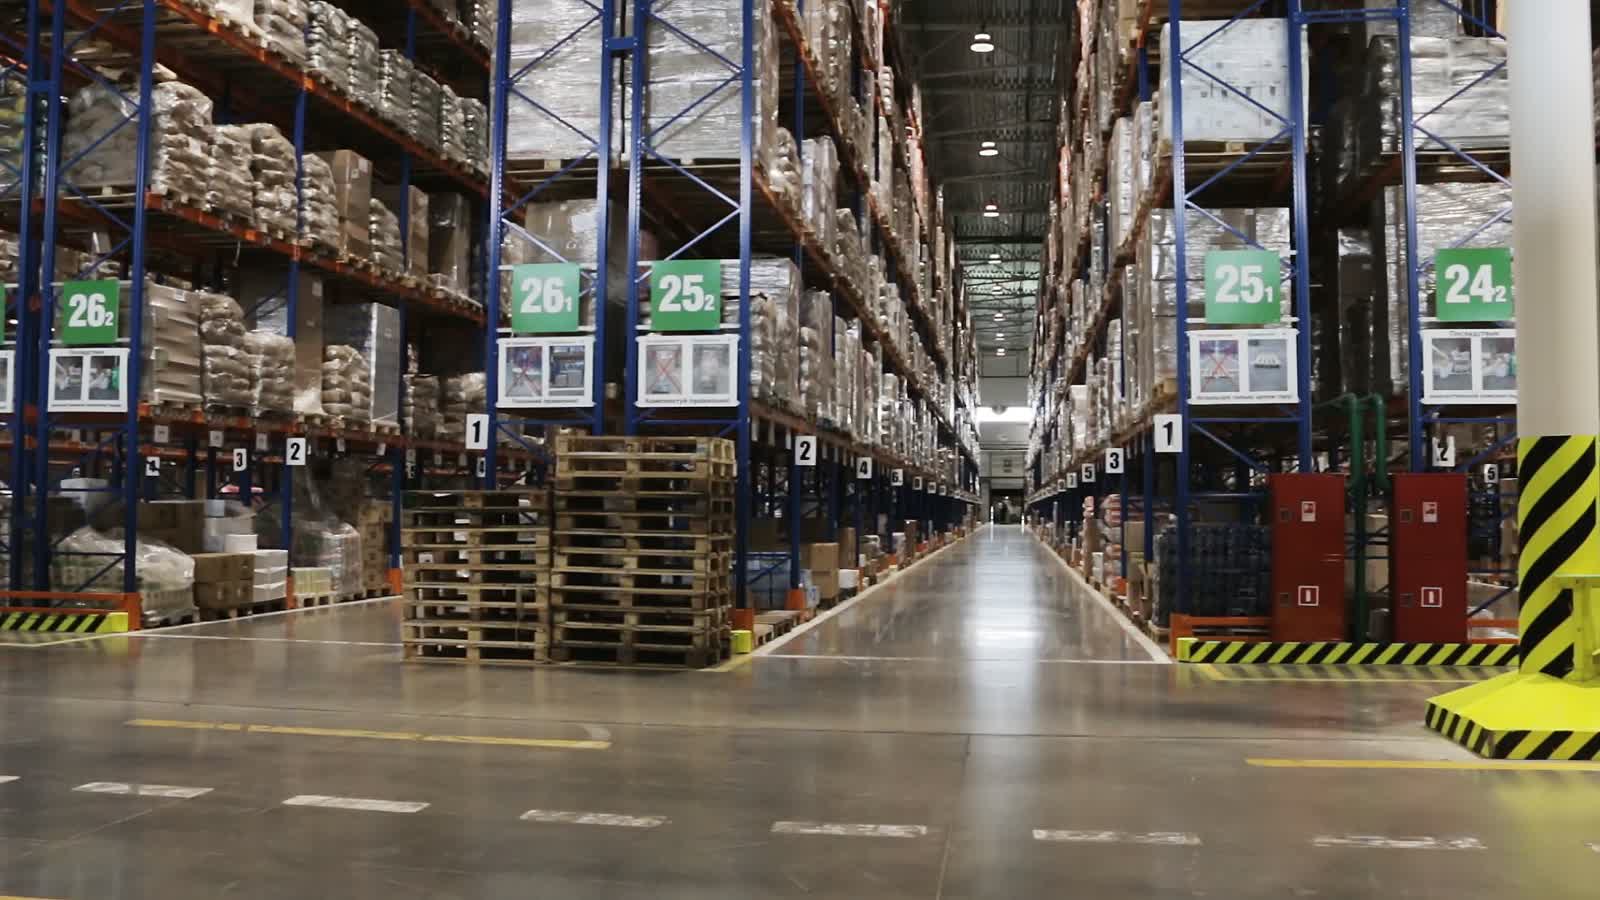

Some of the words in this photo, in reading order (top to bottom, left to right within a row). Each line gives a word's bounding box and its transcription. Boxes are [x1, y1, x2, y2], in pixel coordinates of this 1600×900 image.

[290, 442, 301, 461] 2
[799, 440, 811, 461] 2
[235, 452, 244, 468] 3
[858, 460, 869, 475] 4
[1109, 451, 1120, 470] 3
[891, 471, 899, 483] 6
[1084, 465, 1094, 480] 5
[1487, 466, 1497, 481] 5
